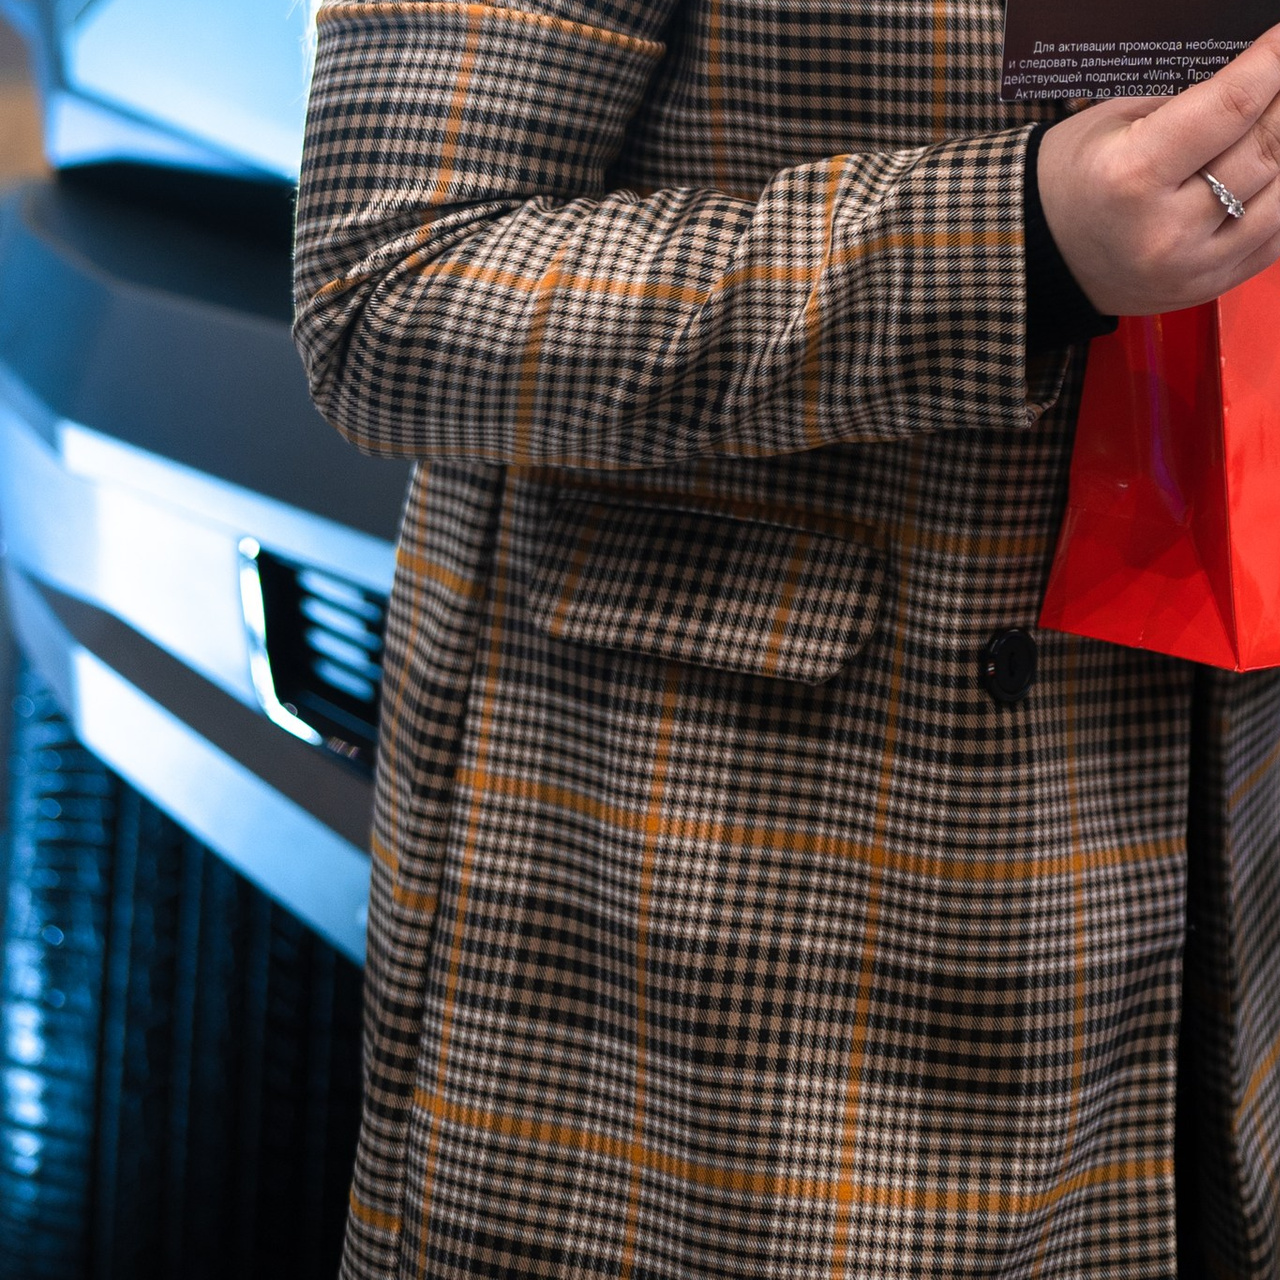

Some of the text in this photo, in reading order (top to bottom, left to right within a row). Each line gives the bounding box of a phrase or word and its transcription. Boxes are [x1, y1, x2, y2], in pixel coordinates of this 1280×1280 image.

[1033, 41, 1055, 54] Для
[1058, 41, 1116, 53] активации
[1119, 40, 1183, 53] промокода
[1008, 54, 1230, 69] и следовать дальнейшим инструкциям
[1004, 71, 1083, 86] действующей
[1085, 71, 1140, 83] подписки
[1142, 69, 1184, 81] «Wink».
[1015, 87, 1093, 100] Активировать
[1095, 86, 1111, 98] до
[1113, 83, 1174, 96] 31.03.2024
